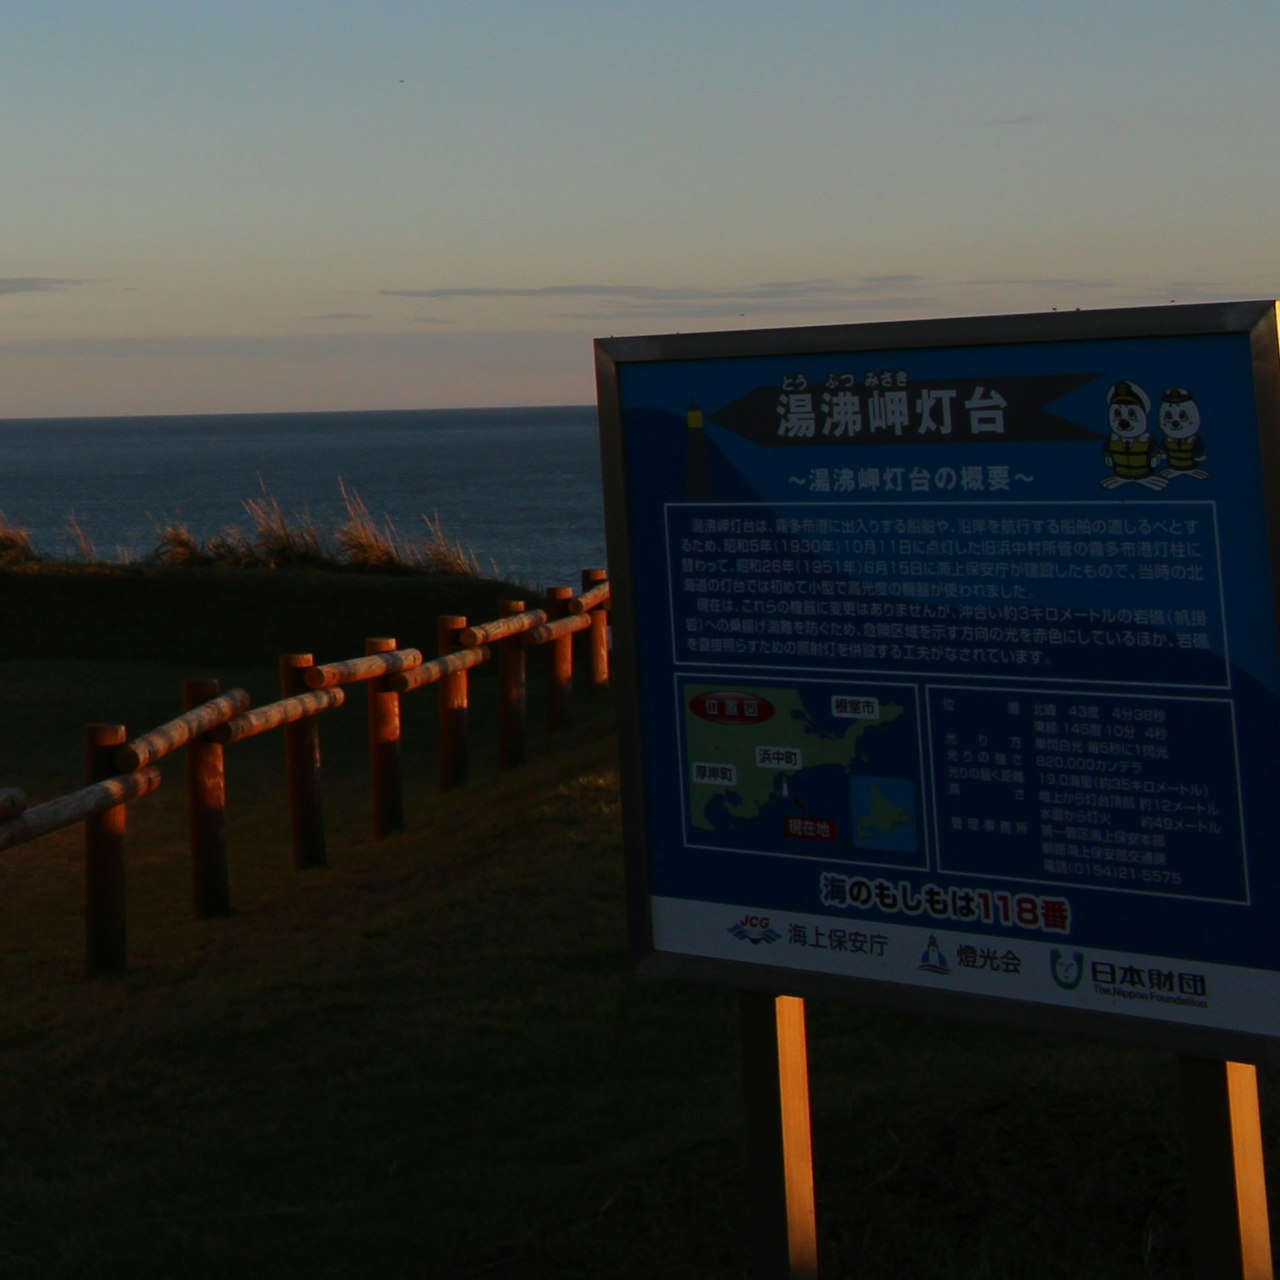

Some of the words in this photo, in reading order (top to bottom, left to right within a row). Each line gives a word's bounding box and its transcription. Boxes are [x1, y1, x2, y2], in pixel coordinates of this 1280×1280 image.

[781, 374, 808, 391] とう
[825, 372, 855, 388] ふつ
[864, 370, 910, 386] みさき
[776, 387, 1008, 438] 湯沸岬灯台
[835, 699, 876, 715] 根室市
[759, 748, 798, 766] 浜中町
[695, 765, 733, 782] 厚岸町
[788, 819, 832, 838] 現在地
[822, 874, 1069, 931] 海のもしもは118番
[740, 914, 771, 929] JCG
[788, 922, 890, 957] 海上保安庁
[956, 943, 1022, 974] 燈光会
[1090, 961, 1207, 997] 日本財団
[1112, 987, 1149, 1002] Nippon
[1149, 991, 1208, 1008] Foundation
